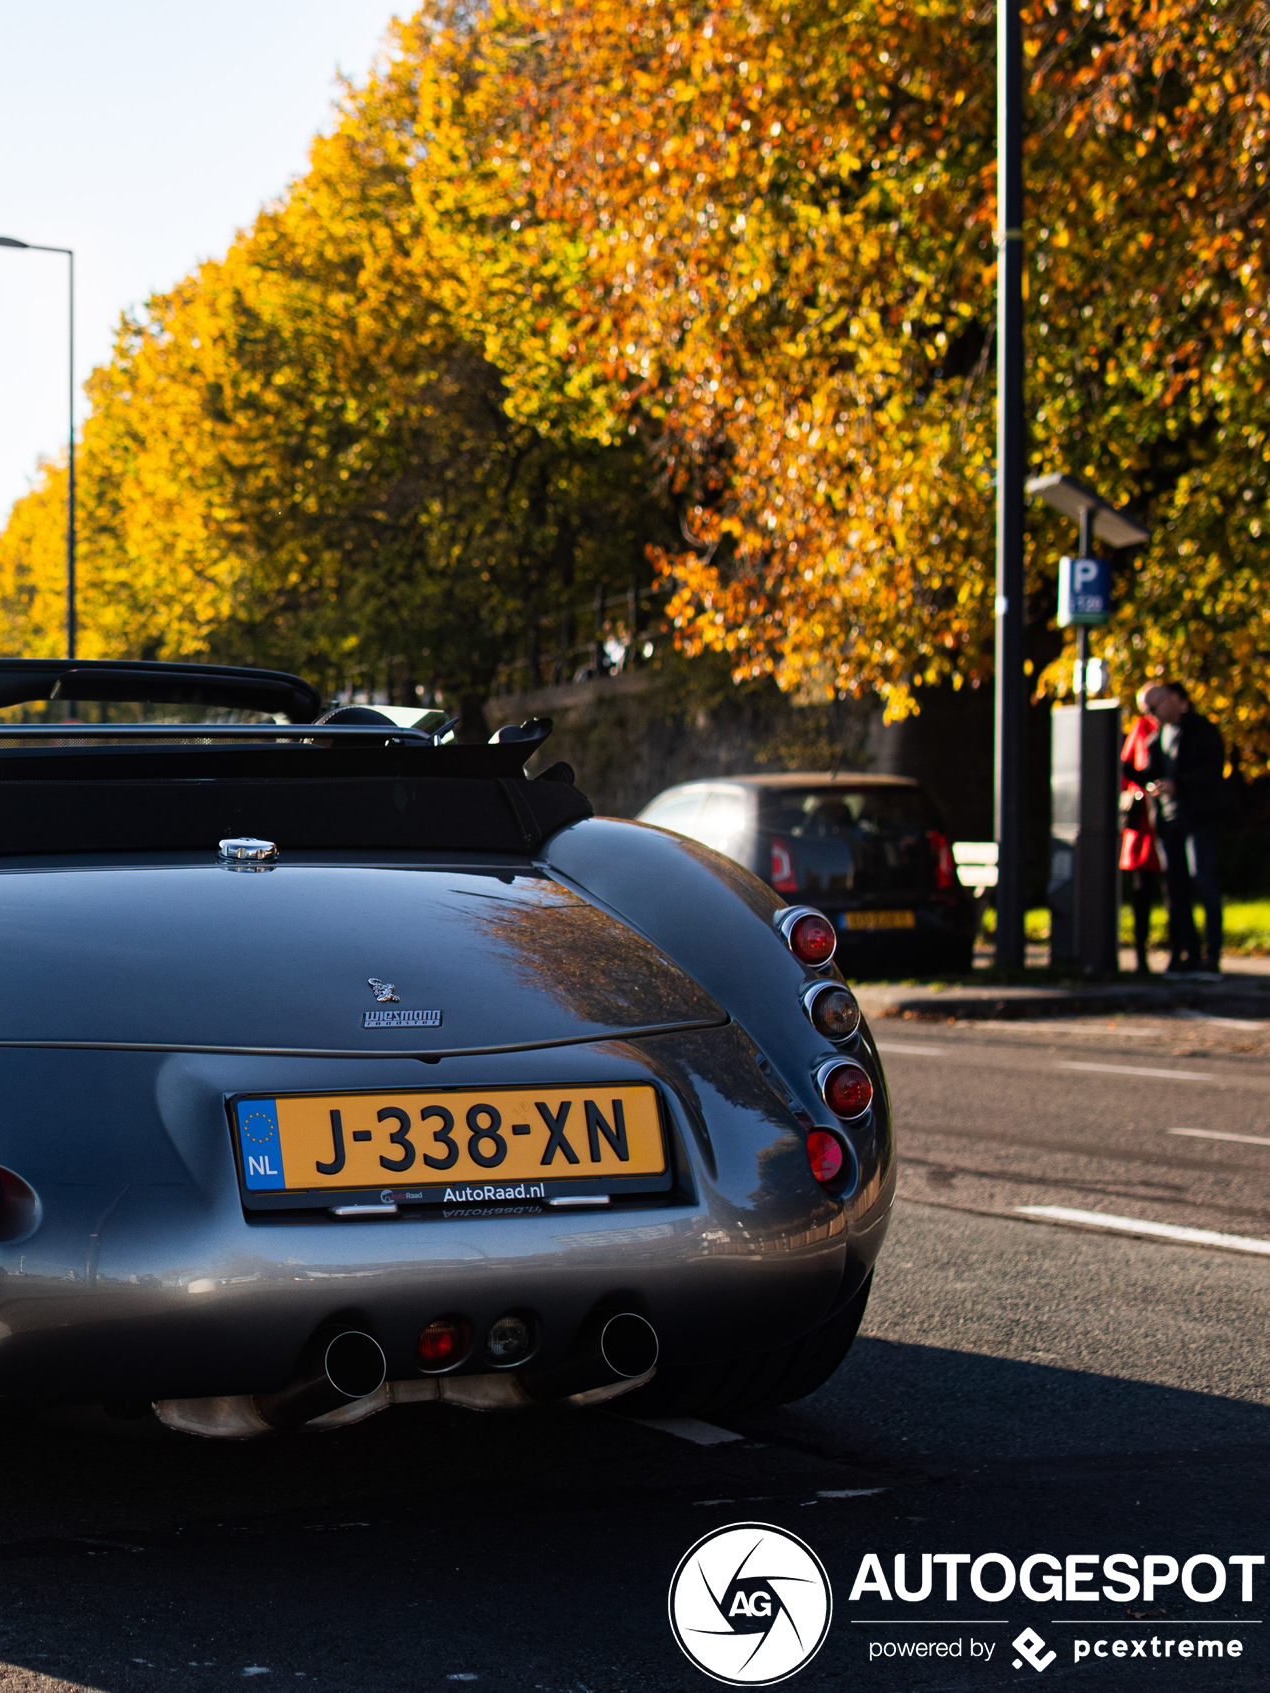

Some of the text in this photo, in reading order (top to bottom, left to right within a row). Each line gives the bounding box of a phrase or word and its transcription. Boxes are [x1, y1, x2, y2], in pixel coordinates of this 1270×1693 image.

[1074, 559, 1099, 593] P
[316, 1099, 630, 1175] J-338-XN
[248, 1155, 278, 1176] NL
[443, 1182, 545, 1202] AutoRaad.nl
